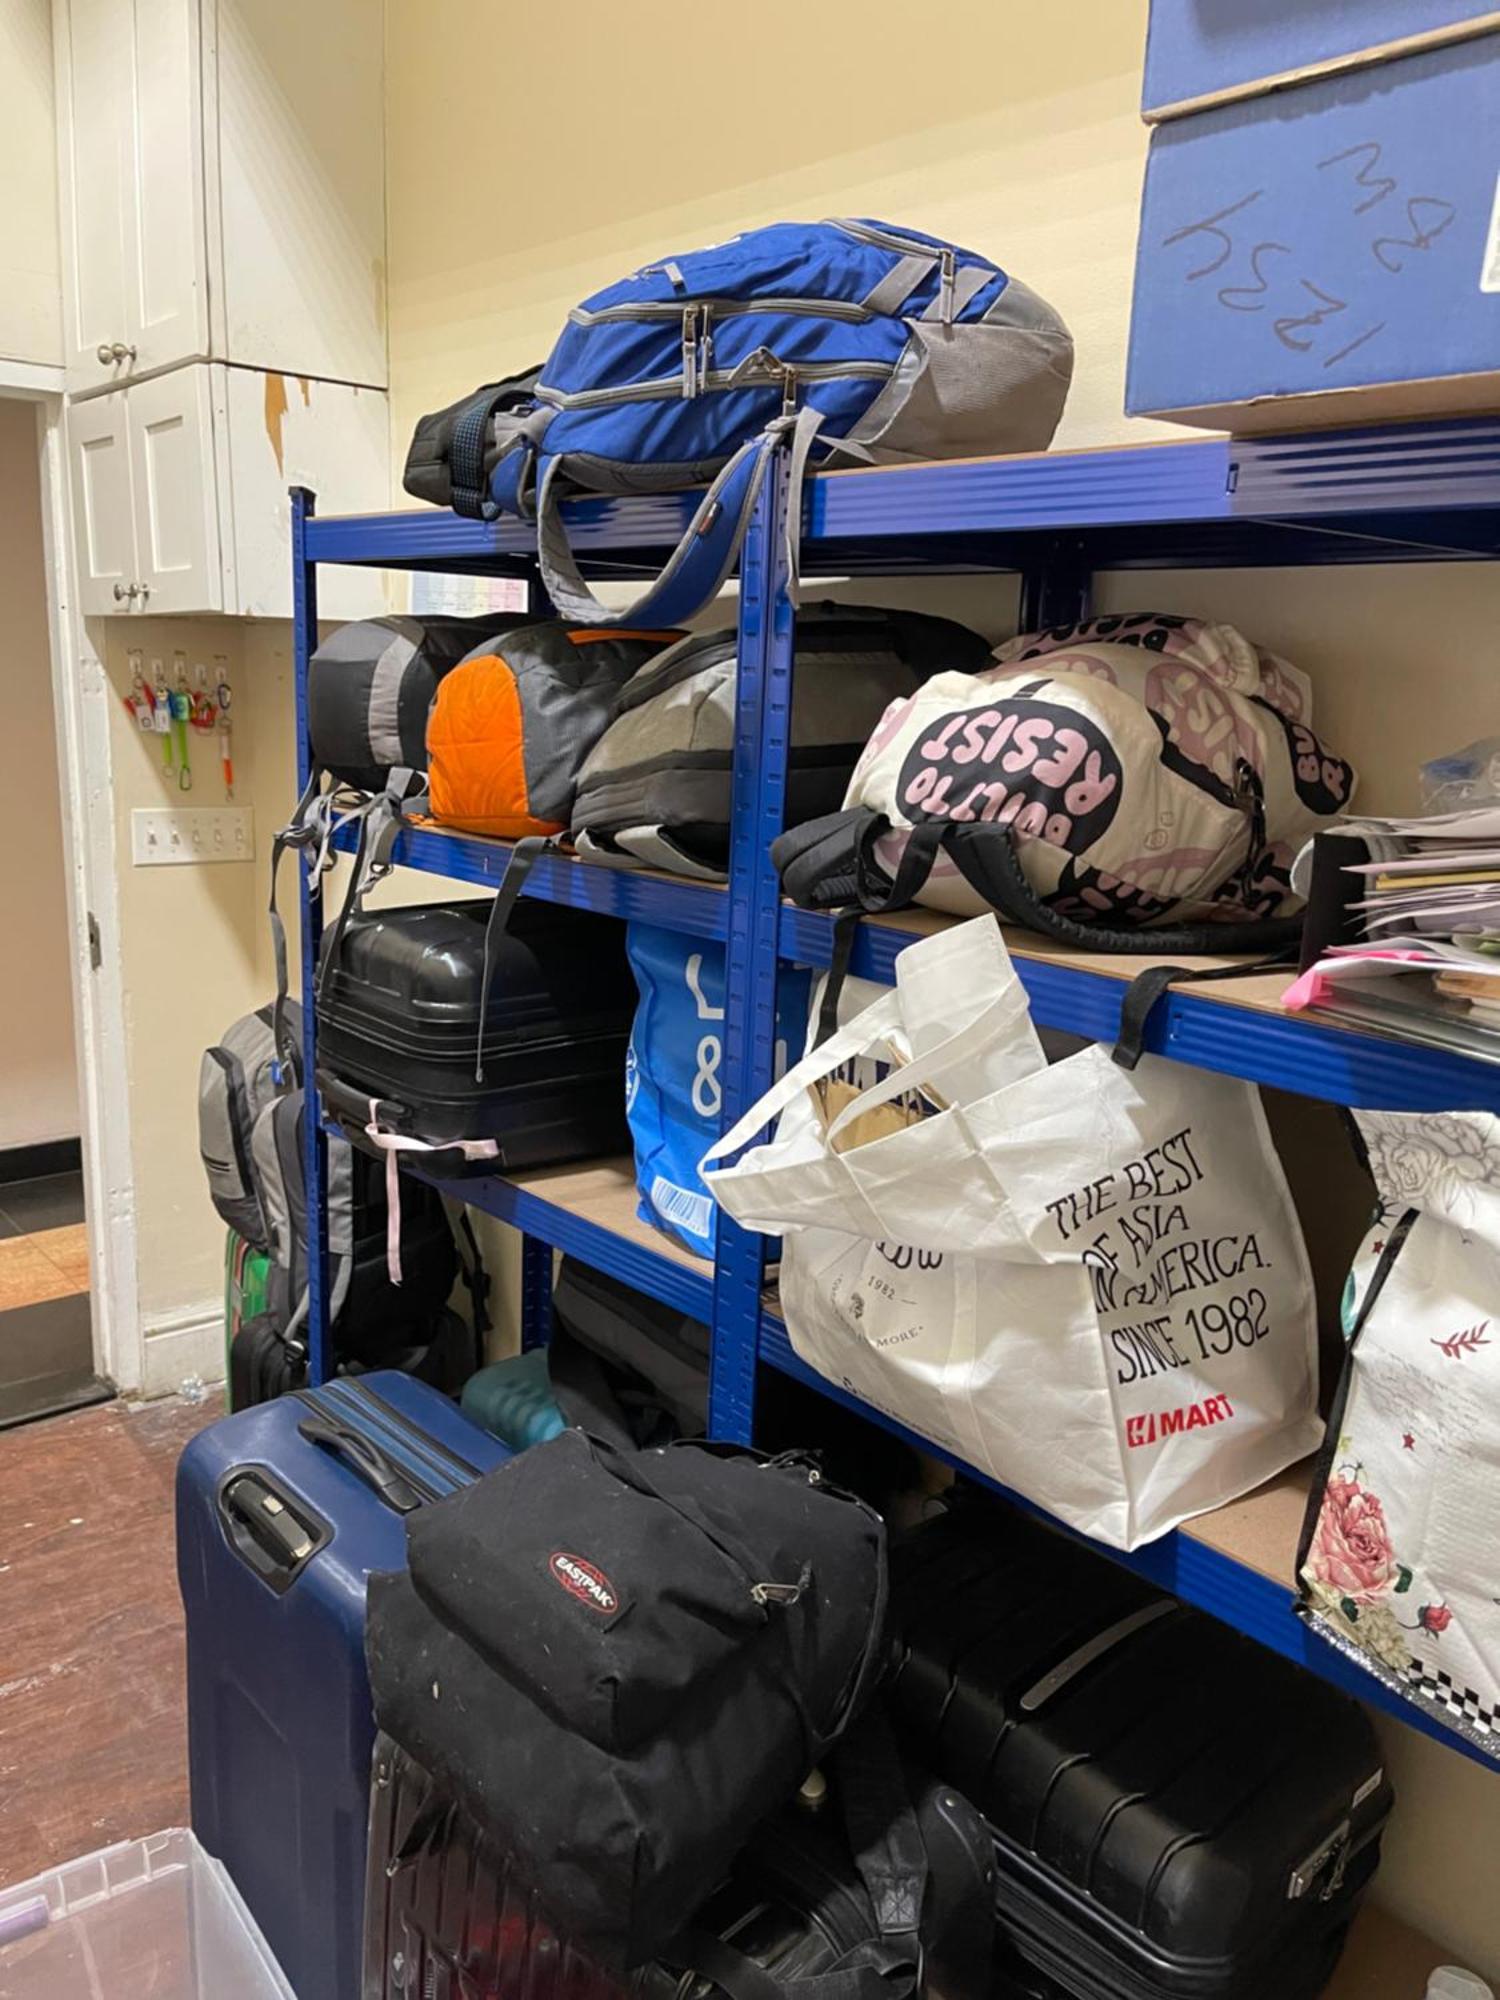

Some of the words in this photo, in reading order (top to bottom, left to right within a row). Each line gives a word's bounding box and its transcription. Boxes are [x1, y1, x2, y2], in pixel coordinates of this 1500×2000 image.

[1162, 189, 1387, 368] 1234
[904, 766, 950, 816] TO
[920, 709, 1117, 816] RESIST
[1045, 1175, 1118, 1240] THE
[1122, 1127, 1204, 1201] BEST
[1117, 1204, 1191, 1268] ASIA
[868, 1275, 896, 1301] 1982
[1111, 1316, 1192, 1384] SINCE
[1185, 1288, 1270, 1360] 1982
[1160, 1393, 1234, 1437] MART
[555, 1556, 612, 1608] EASTPAK
